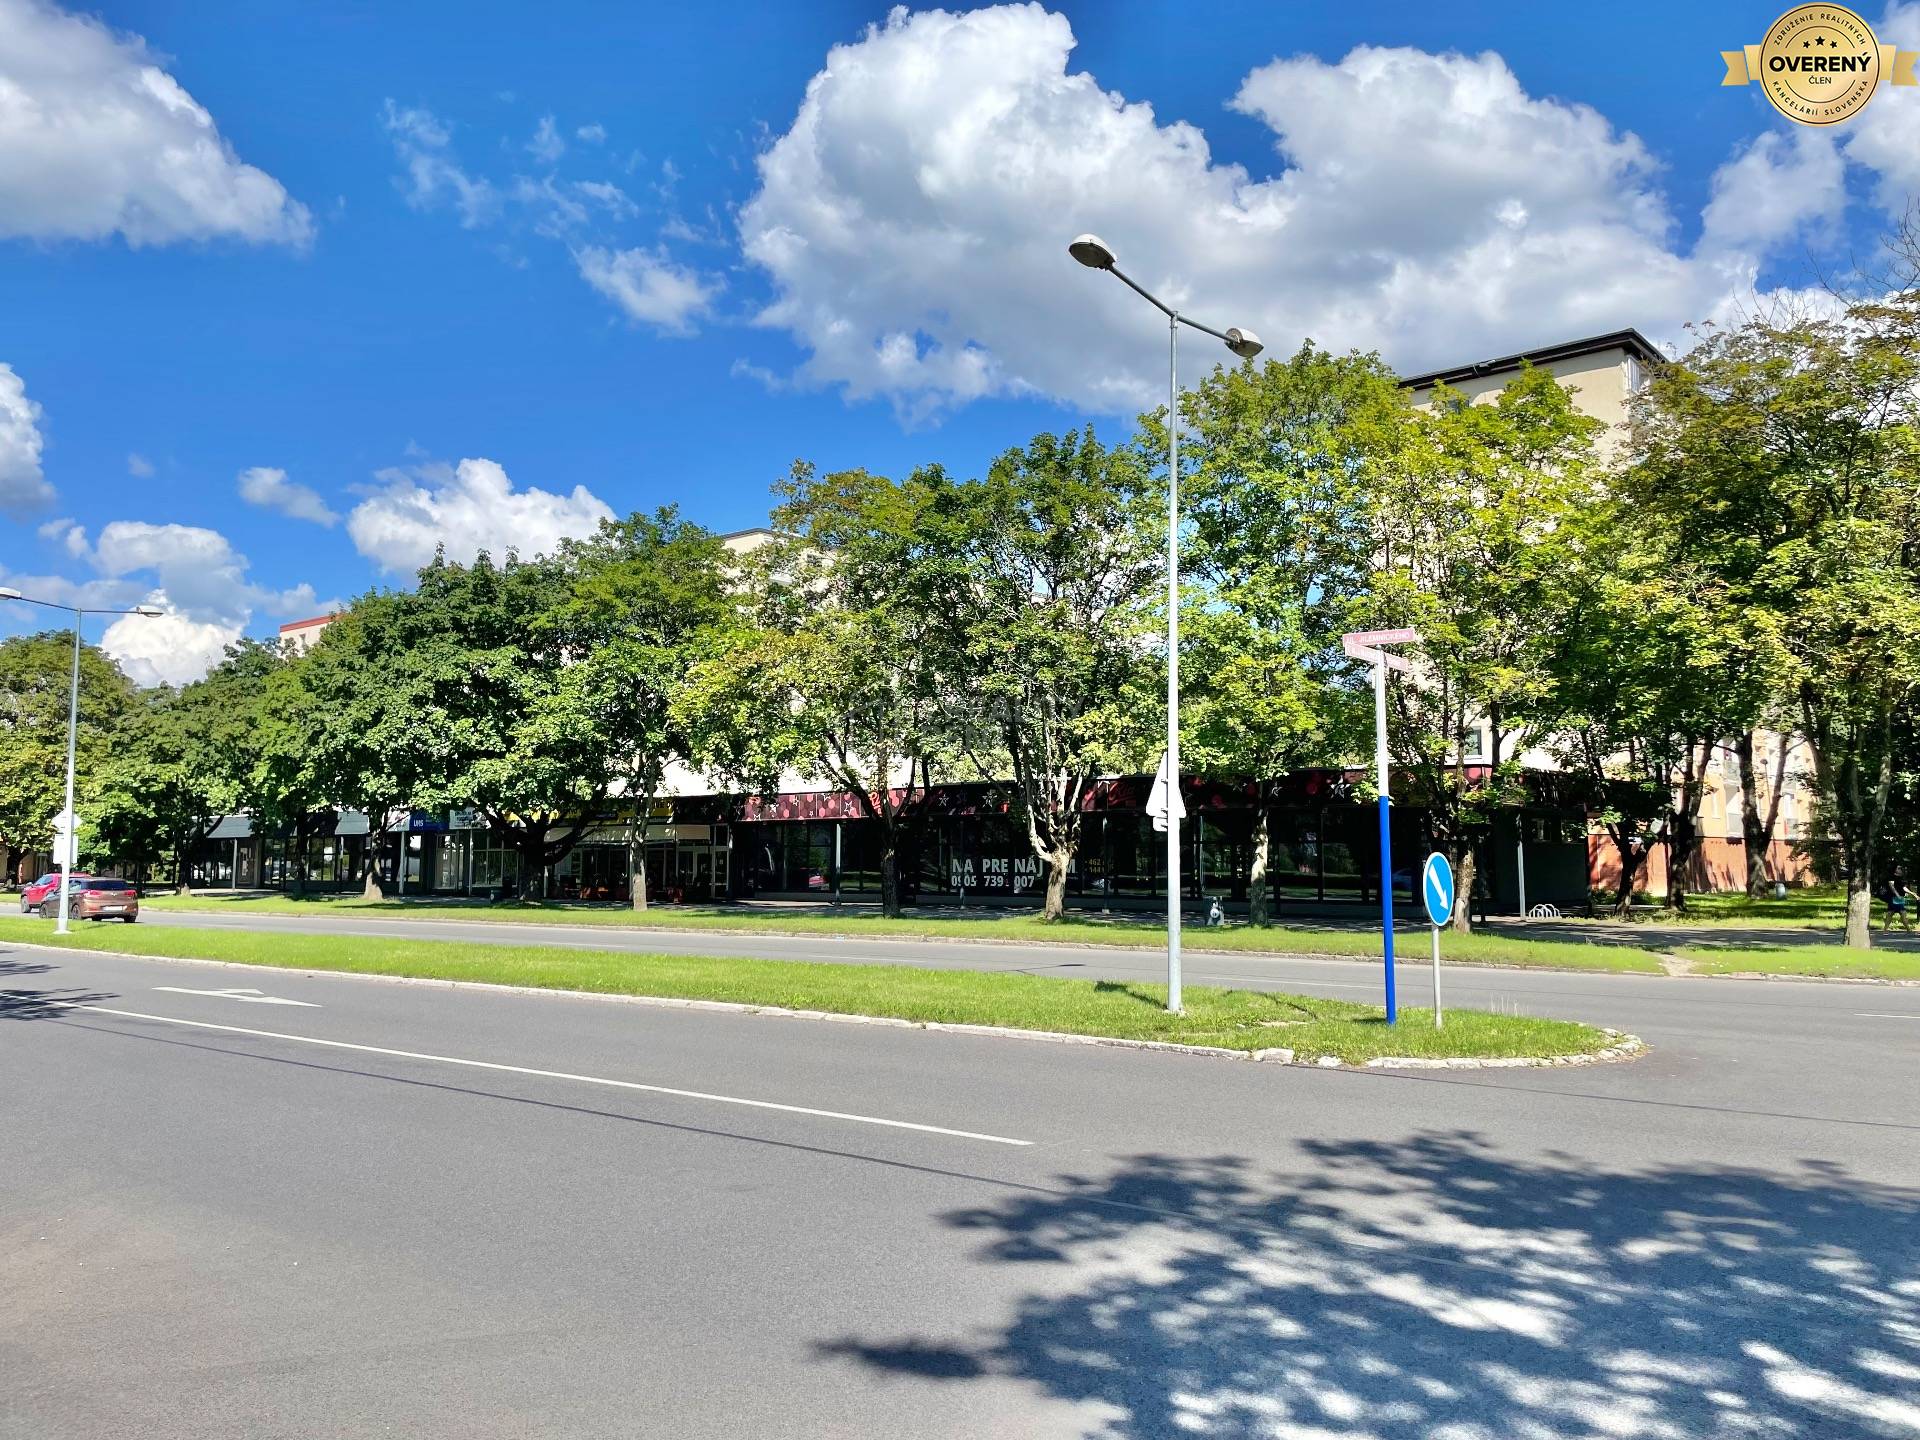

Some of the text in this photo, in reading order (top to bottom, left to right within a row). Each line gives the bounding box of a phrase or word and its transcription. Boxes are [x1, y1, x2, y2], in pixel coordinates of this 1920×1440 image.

[952, 858, 974, 873] NA
[984, 875, 1004, 887] 739
[1014, 875, 1035, 887] 007
